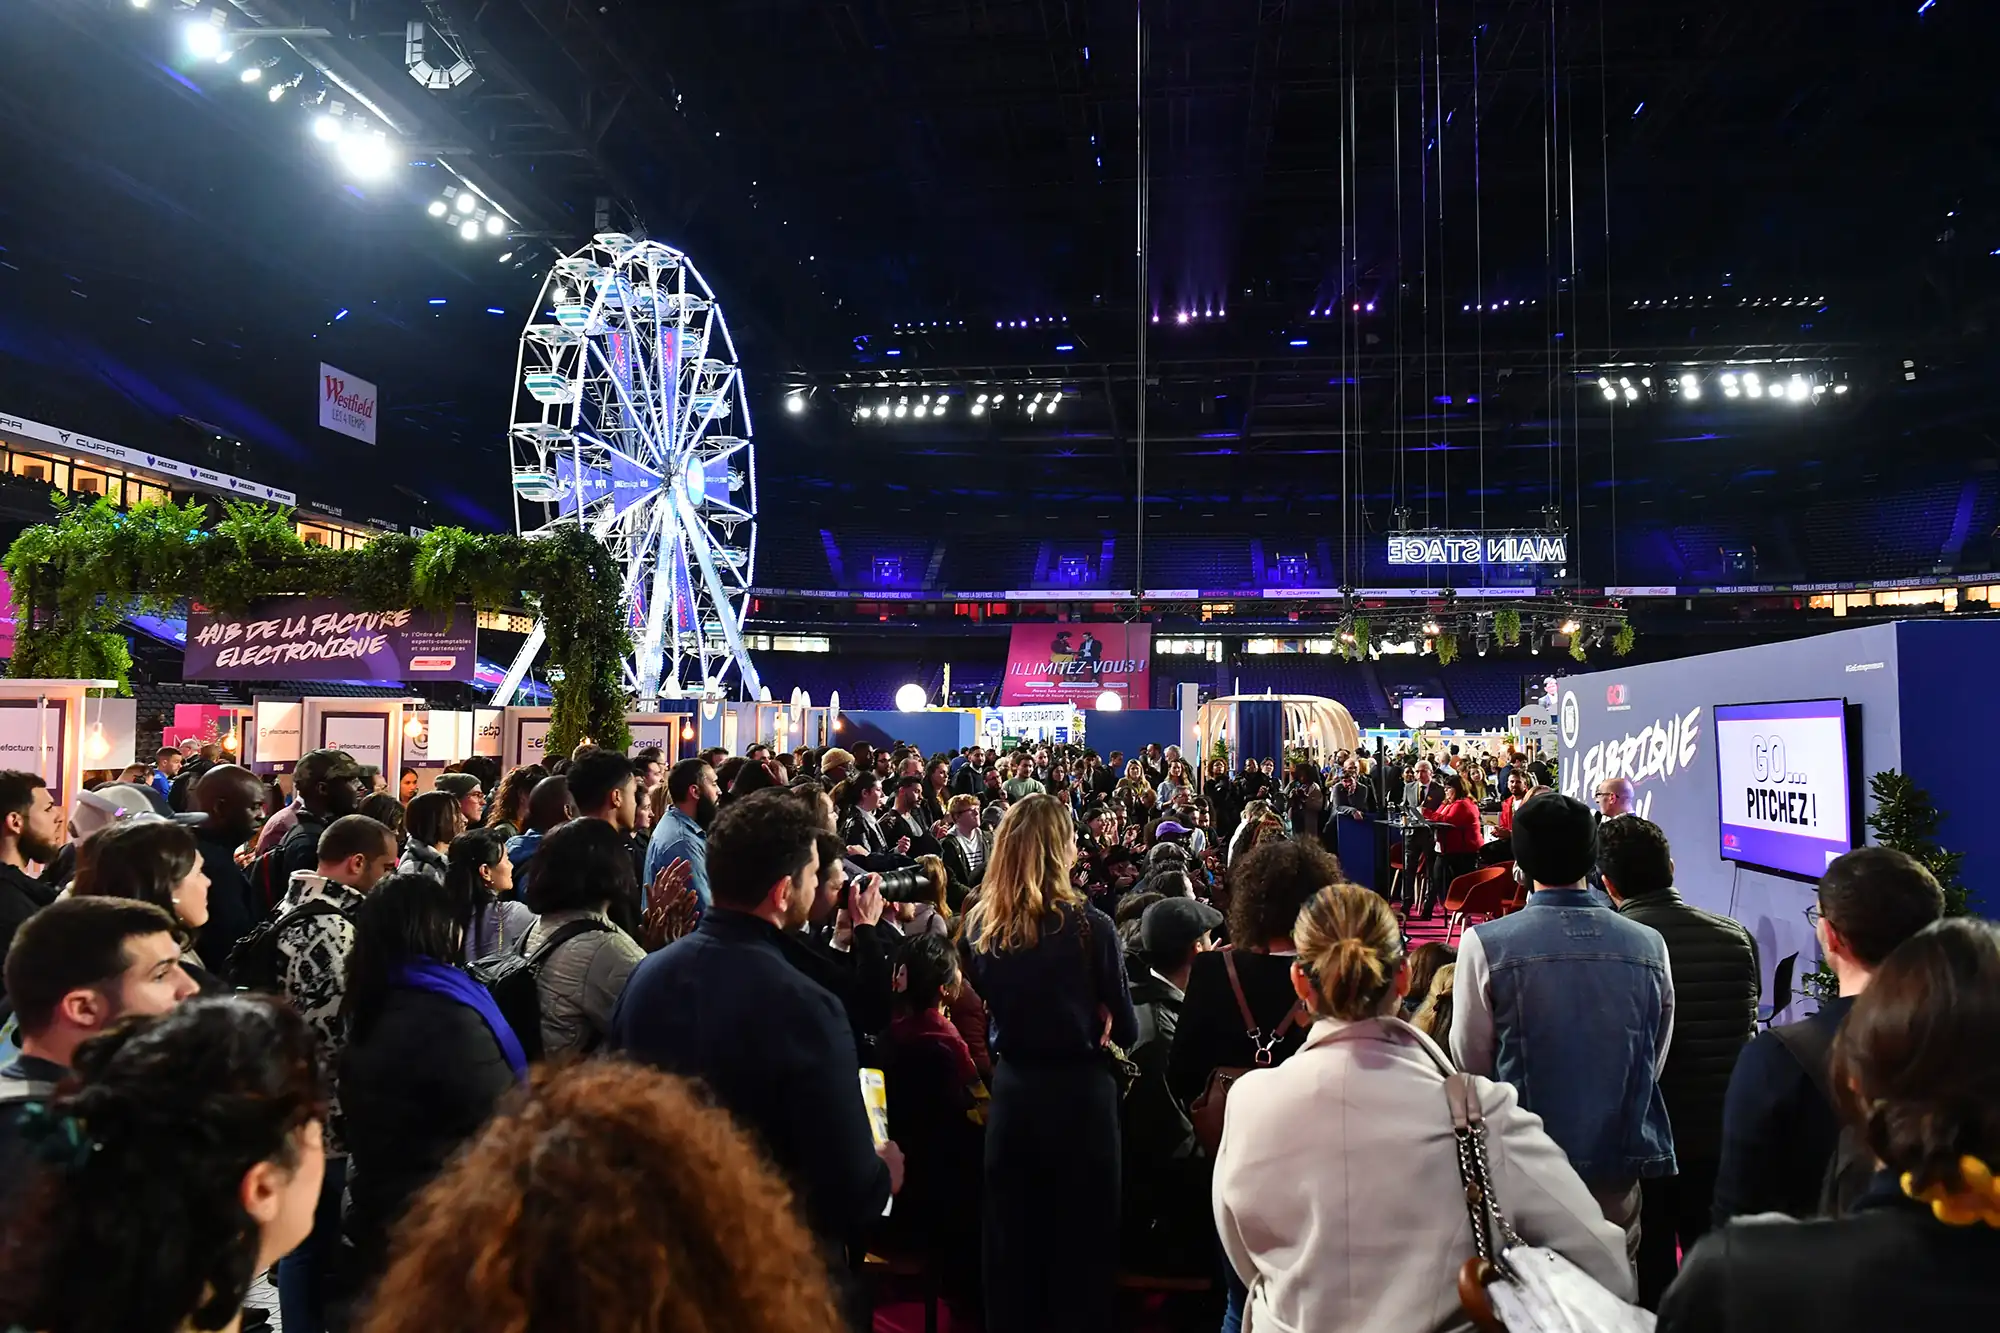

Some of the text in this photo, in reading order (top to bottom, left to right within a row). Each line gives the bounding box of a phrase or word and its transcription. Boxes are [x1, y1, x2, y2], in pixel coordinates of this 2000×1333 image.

[324, 375, 374, 418] Westfield
[0, 418, 22, 430] RA
[332, 408, 366, 432] LES 4 TEMPS
[76, 438, 126, 457] CUPRA
[158, 460, 178, 470] DEEZER
[200, 472, 218, 481] DEEZER
[238, 482, 256, 492] DEEZER
[274, 492, 290, 500] DEEZER
[312, 501, 342, 512] MAYBELLINE
[194, 608, 412, 647] HUB DE LA FACTURE
[216, 634, 388, 668] ELECTRONIQUE
[1011, 660, 1146, 675] ILLIMITEZ-VOUS !
[1021, 711, 1032, 722] FOR
[1033, 710, 1064, 721] STARTUPS
[484, 722, 500, 739] ebp
[1562, 750, 1580, 798] LA
[1583, 706, 1700, 800] FABRIQUE
[1747, 788, 1817, 827] PITCHEZ !
